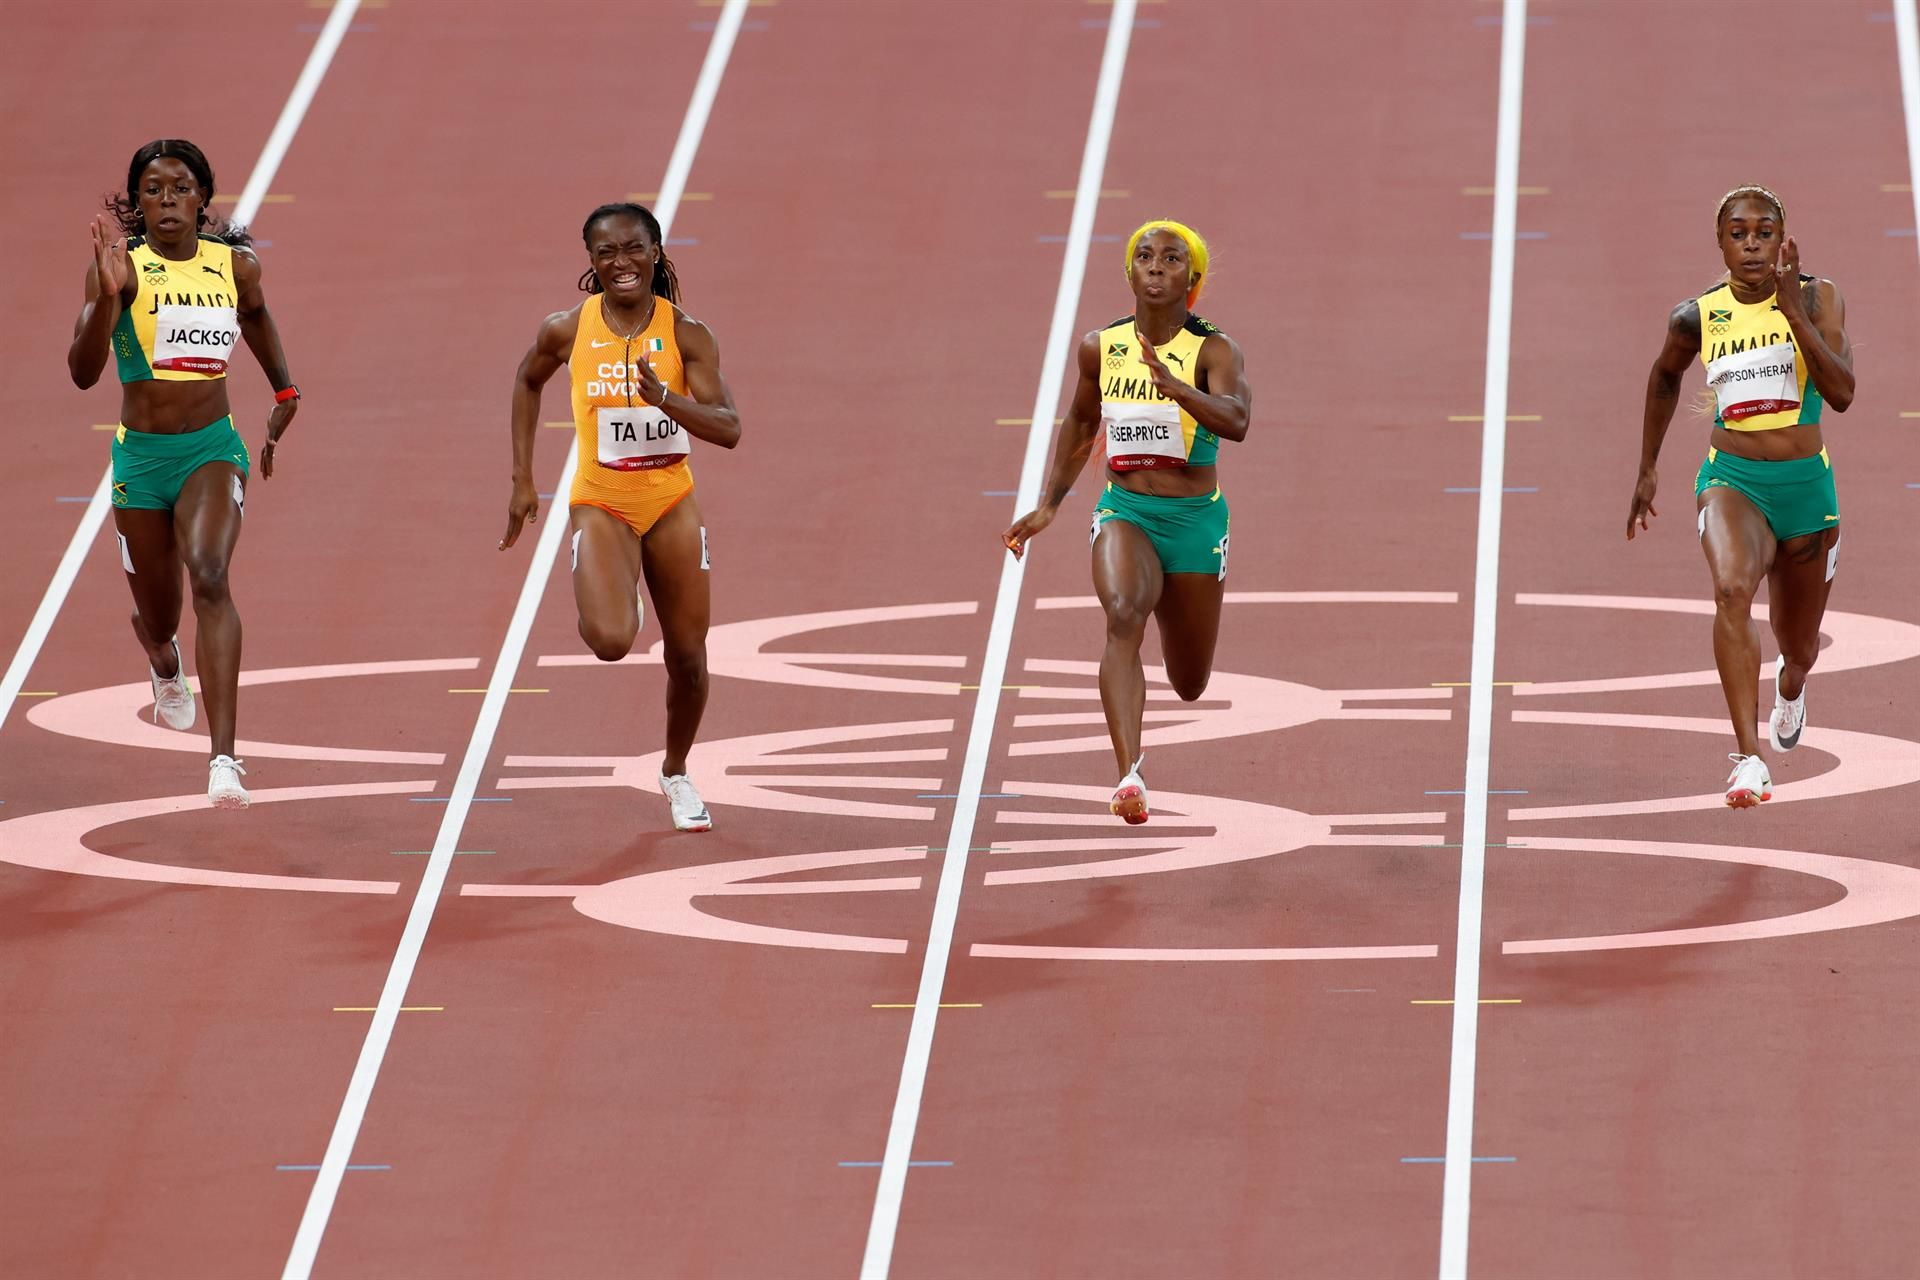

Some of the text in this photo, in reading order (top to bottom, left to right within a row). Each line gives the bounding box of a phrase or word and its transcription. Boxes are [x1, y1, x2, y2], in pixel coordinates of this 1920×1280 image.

[148, 292, 235, 315] JAMAICA
[166, 328, 238, 347] JACKSON
[1708, 331, 1797, 364] JAMAICA
[181, 361, 197, 369] TOKYO
[597, 360, 657, 379] CÔT
[1103, 375, 1173, 402] JAMAI
[1731, 406, 1746, 415] TOKYO
[610, 418, 679, 442] TA LOU
